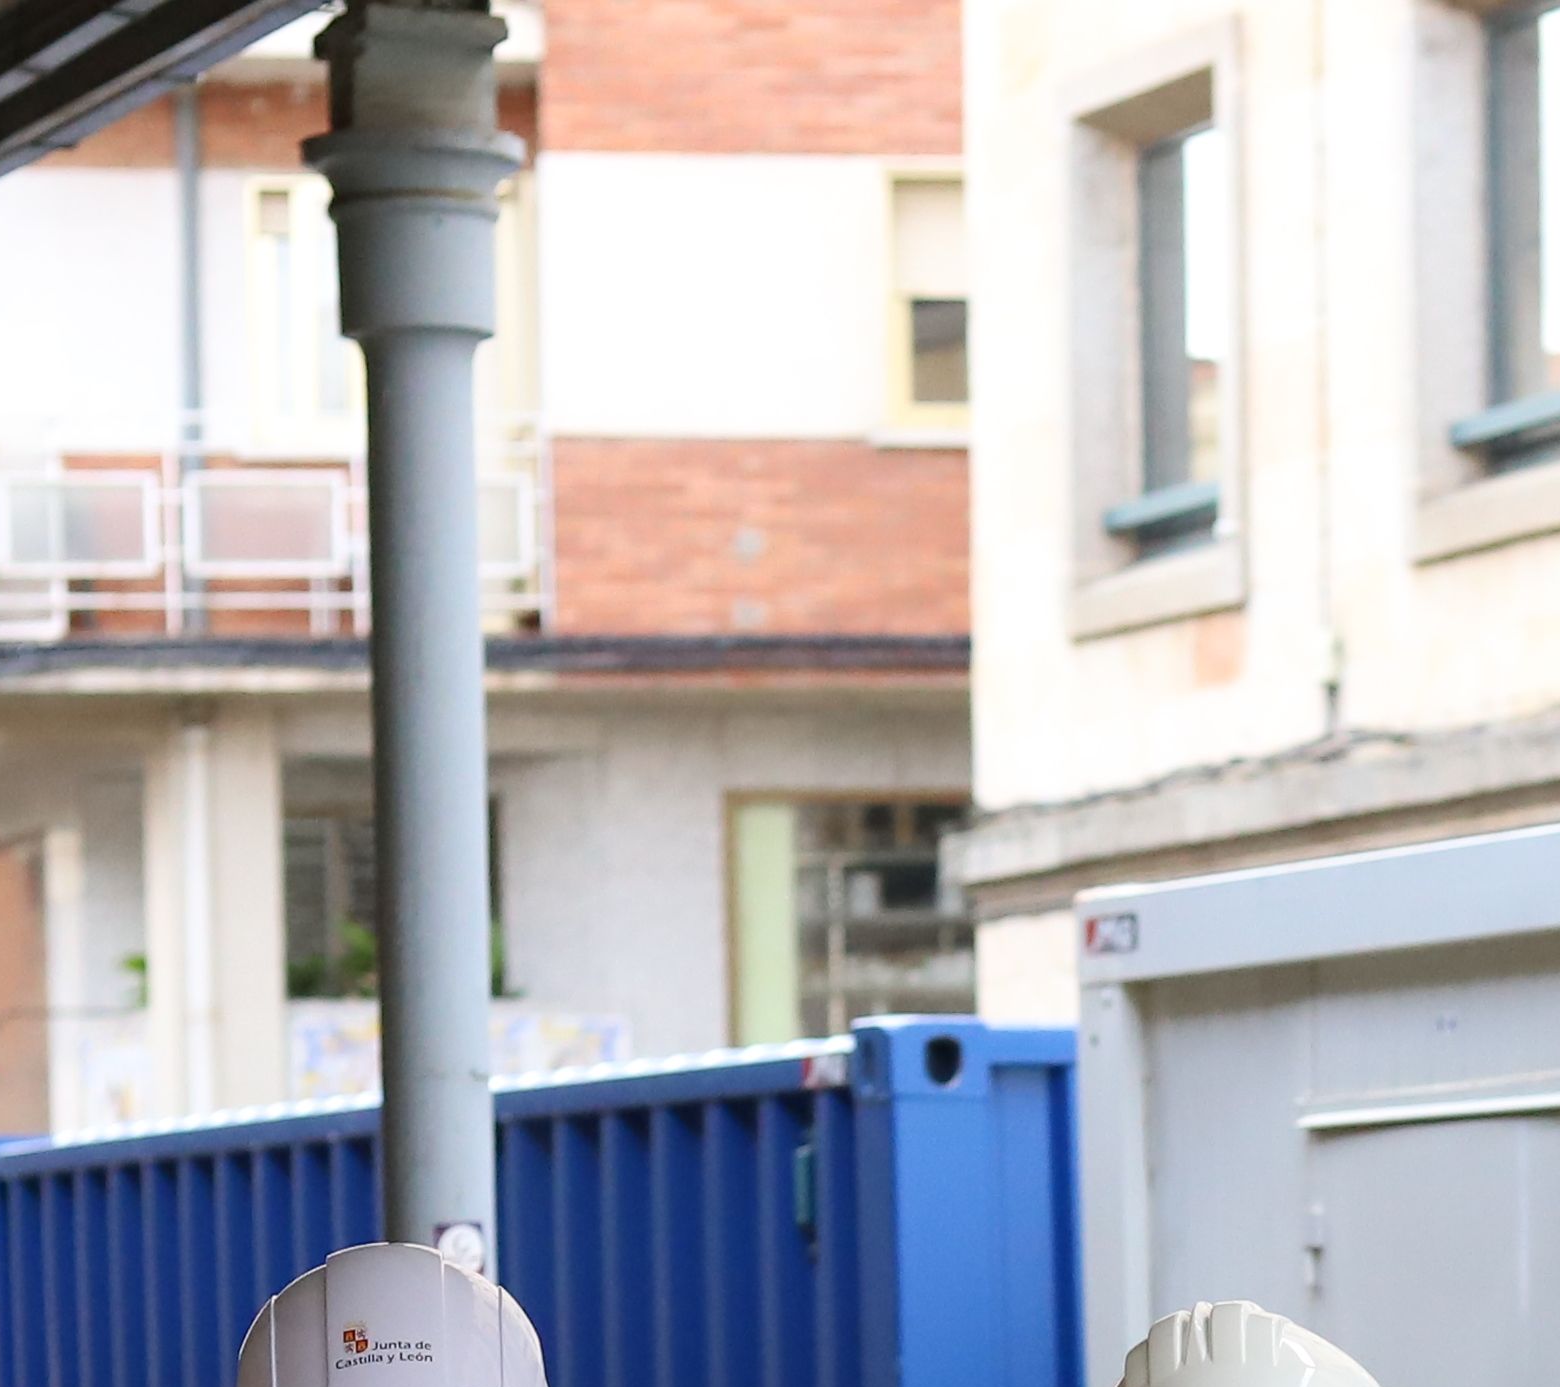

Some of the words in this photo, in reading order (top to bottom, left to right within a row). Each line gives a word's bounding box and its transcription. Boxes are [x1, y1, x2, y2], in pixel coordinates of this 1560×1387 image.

[372, 1341, 411, 1351] Junta
[415, 1341, 432, 1350] de
[335, 1353, 383, 1370] Castilla
[387, 1354, 395, 1364] y
[400, 1352, 433, 1362] León
